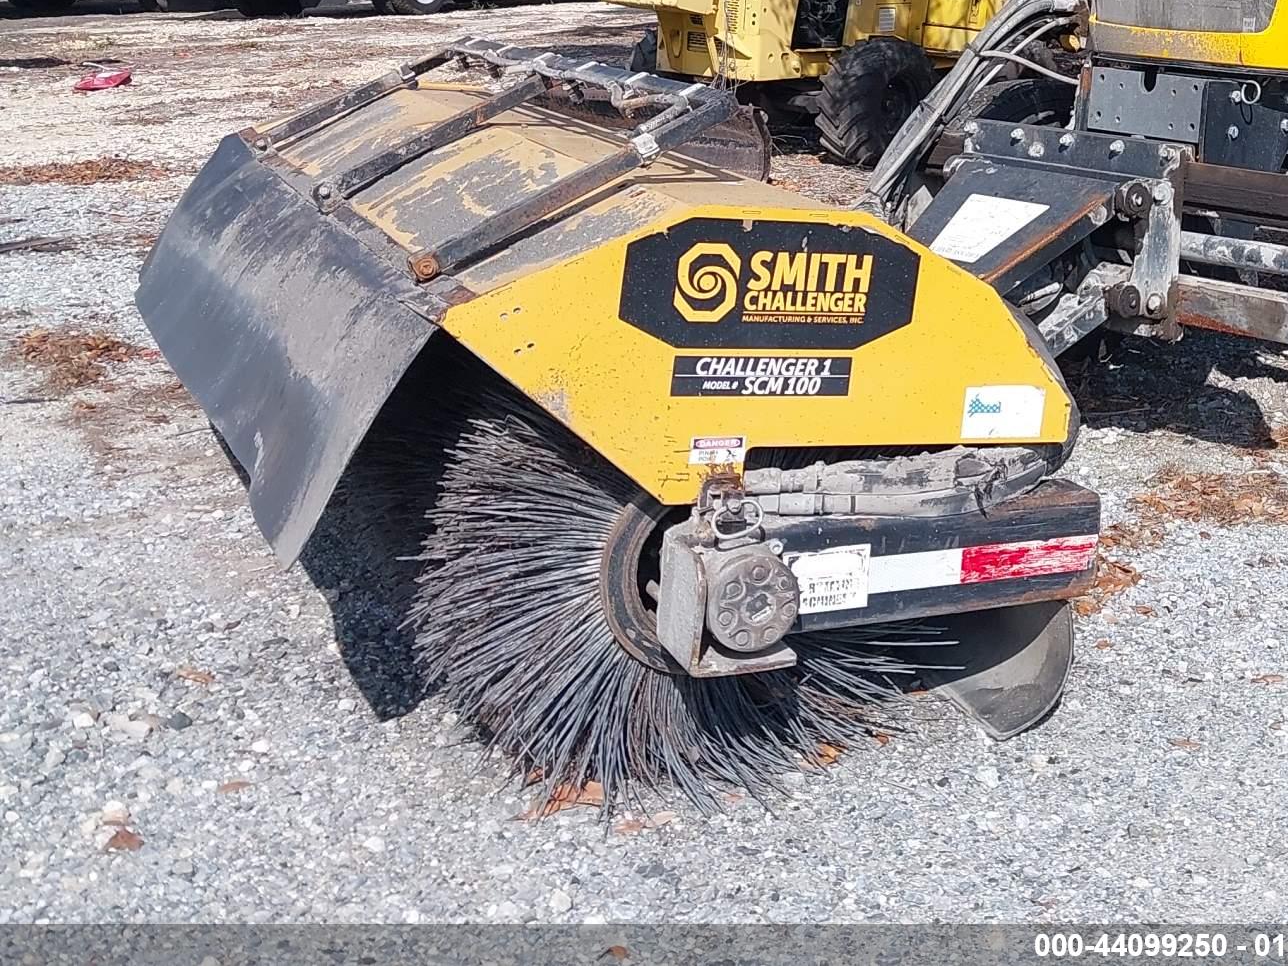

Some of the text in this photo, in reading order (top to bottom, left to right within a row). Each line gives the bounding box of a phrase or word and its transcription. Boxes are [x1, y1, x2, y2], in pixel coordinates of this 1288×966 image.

[747, 250, 873, 293] SMITH
[743, 291, 867, 312] CHALLENGER
[742, 315, 806, 323] MANUFACTURING
[696, 357, 833, 376] CHALLENGER 1
